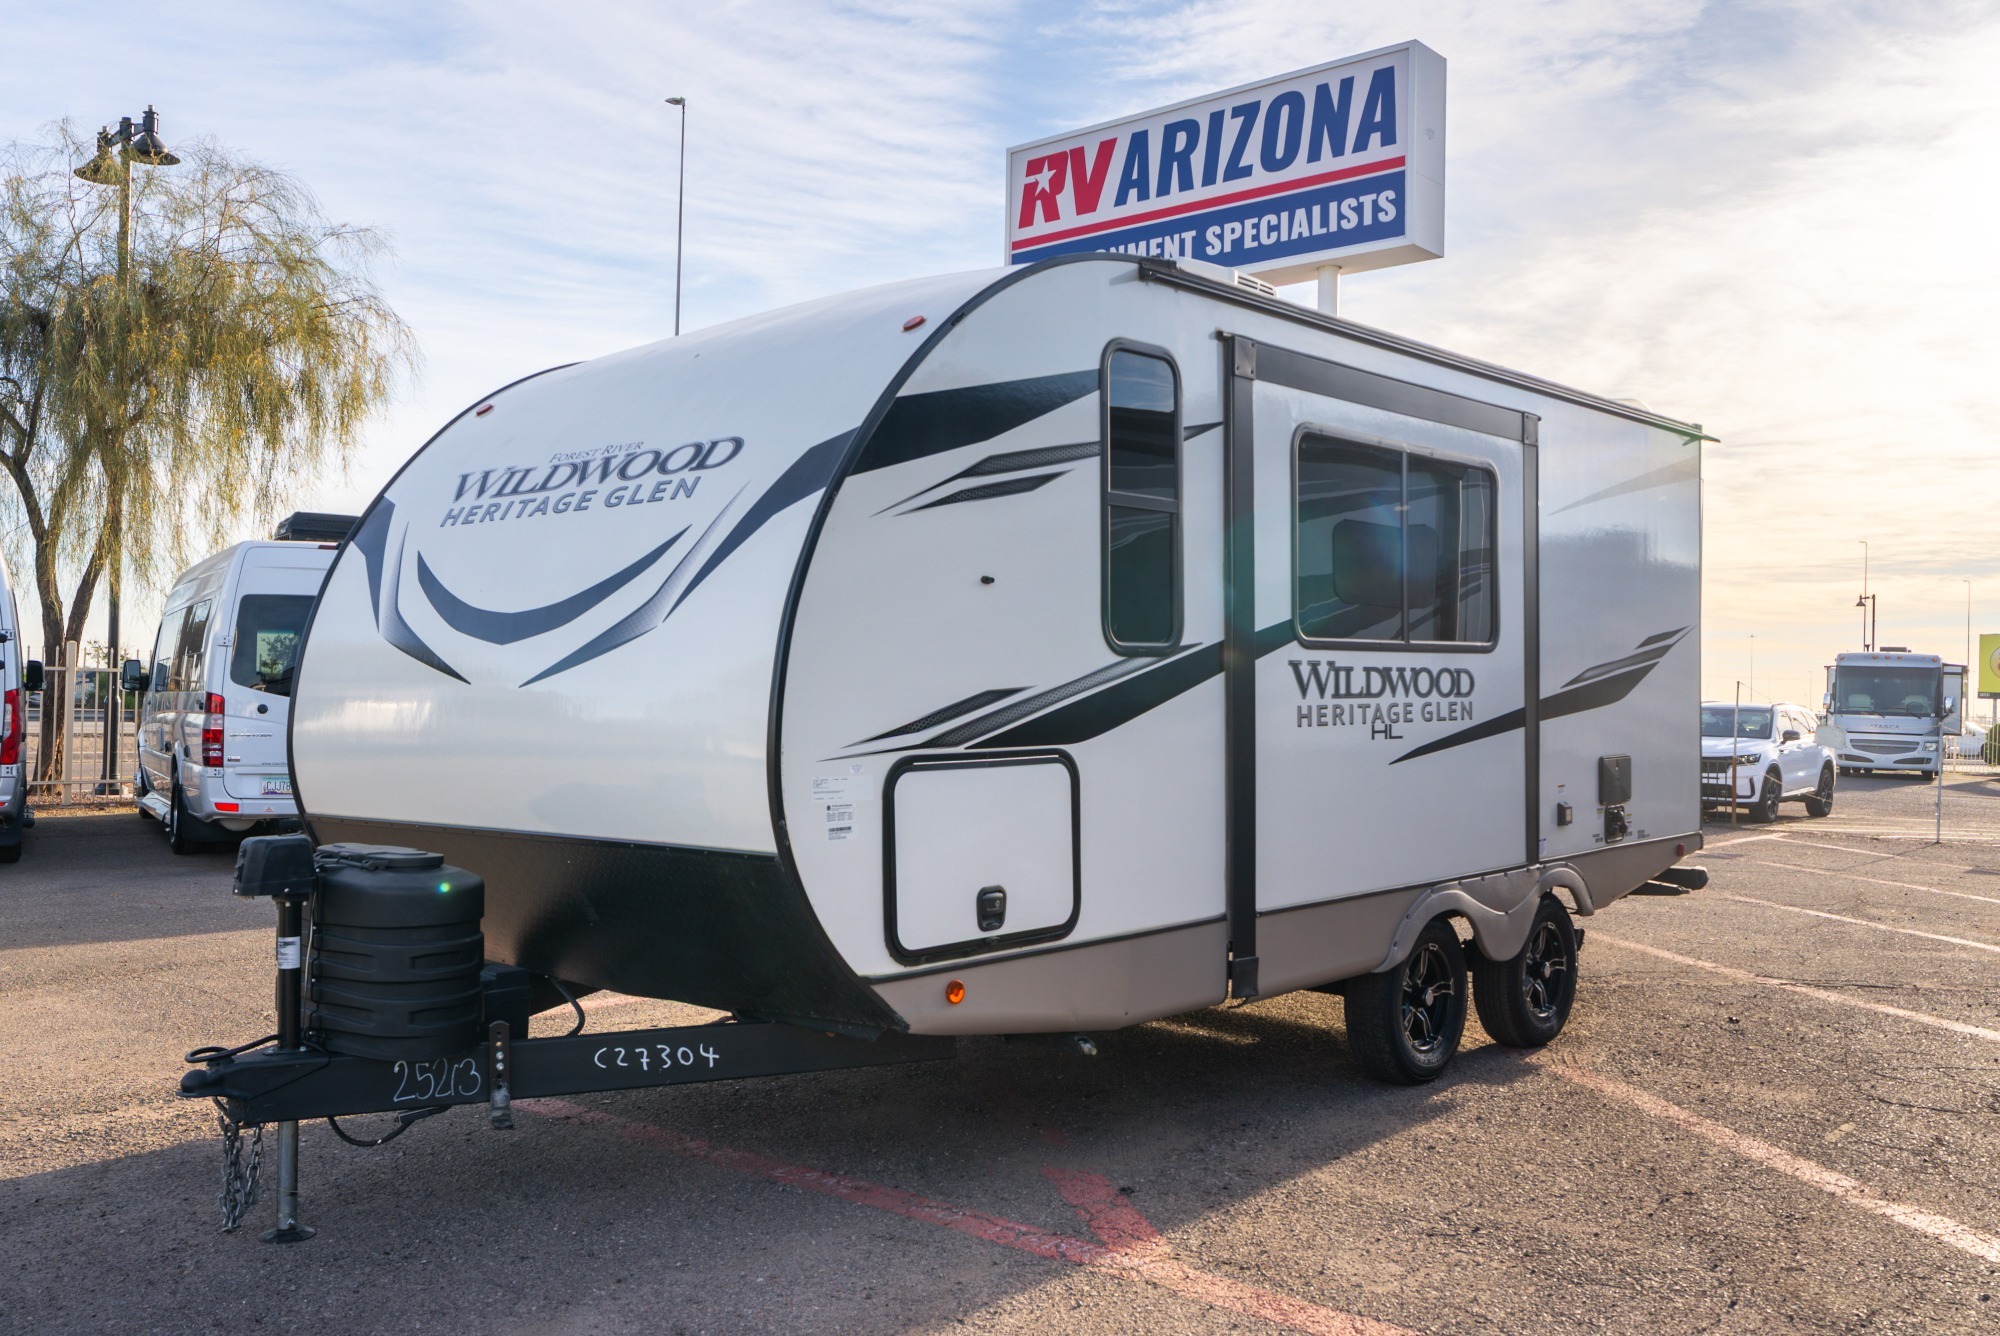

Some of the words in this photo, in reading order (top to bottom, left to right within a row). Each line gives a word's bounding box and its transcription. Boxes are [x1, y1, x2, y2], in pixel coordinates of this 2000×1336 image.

[1113, 65, 1398, 208] ARIZONA
[1205, 190, 1397, 256] SPECIALISTS
[452, 436, 746, 504] WILDWOOD
[548, 448, 602, 463] FOREST
[601, 441, 645, 455] RIVER
[440, 489, 598, 528] HERITAGE
[604, 475, 702, 508] GLEN
[1287, 659, 1476, 700] WILDWOOD
[1296, 702, 1415, 728] HERITAGE
[1420, 700, 1474, 723] GLEN
[1370, 724, 1404, 740] HL
[593, 1042, 721, 1071] C27304
